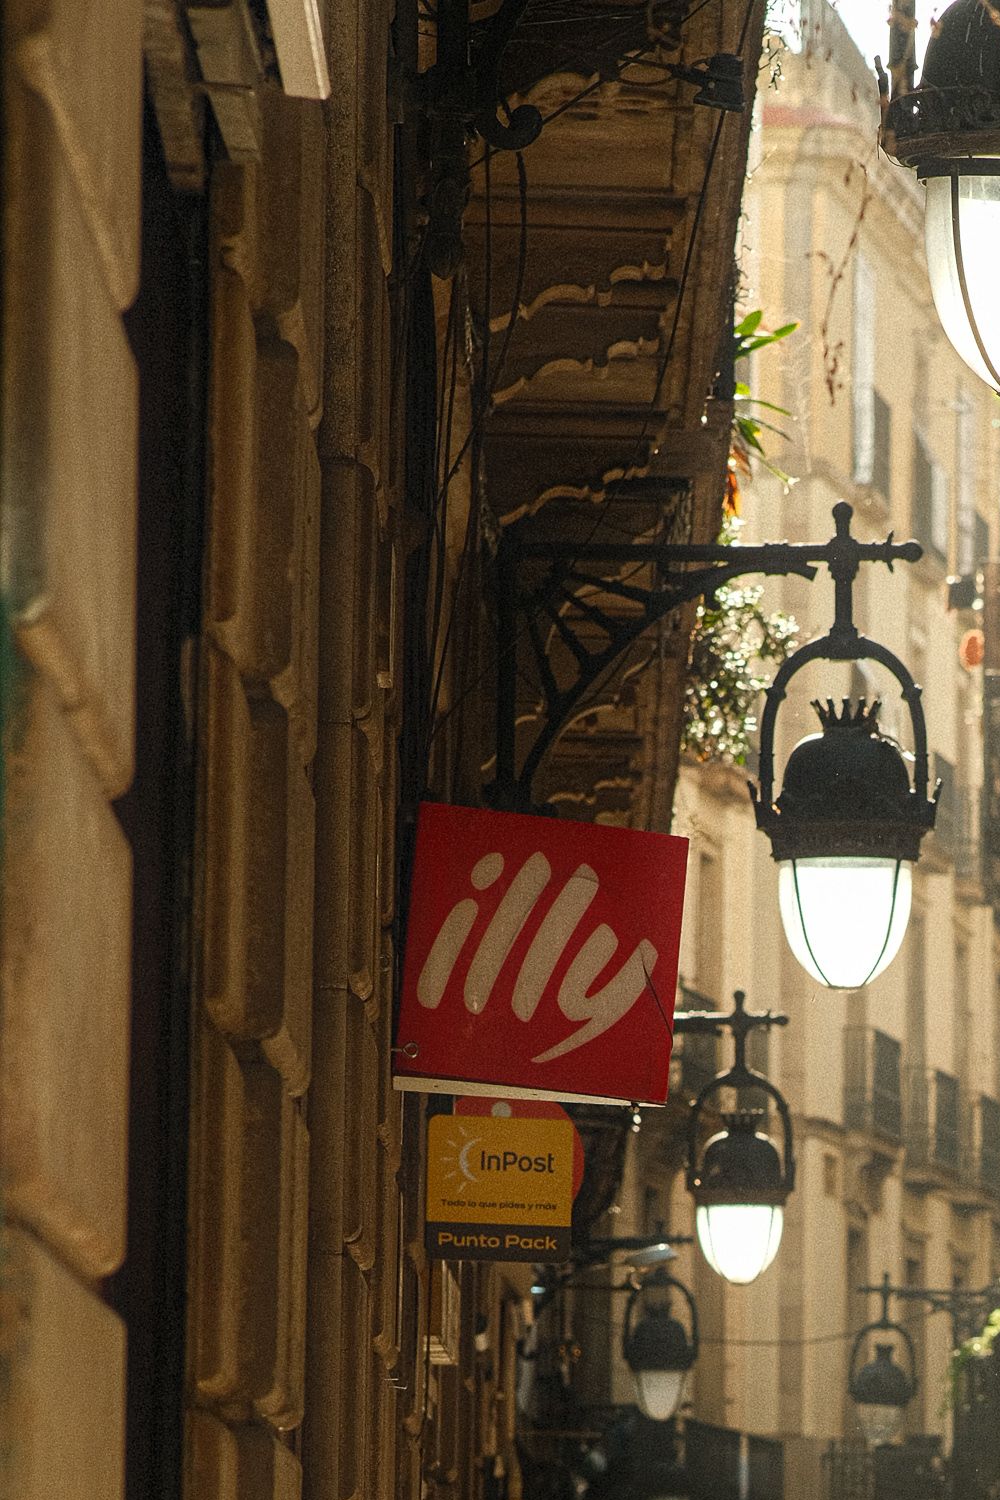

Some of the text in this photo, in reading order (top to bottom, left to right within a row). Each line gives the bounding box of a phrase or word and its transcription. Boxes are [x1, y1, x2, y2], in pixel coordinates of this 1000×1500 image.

[417, 851, 658, 1063] illy
[480, 1151, 555, 1173] InPost
[441, 1198, 466, 1207] Todo
[468, 1199, 476, 1208] lo
[499, 1201, 526, 1210] pides
[528, 1203, 534, 1211] y
[438, 1232, 558, 1251] Punto Pack
